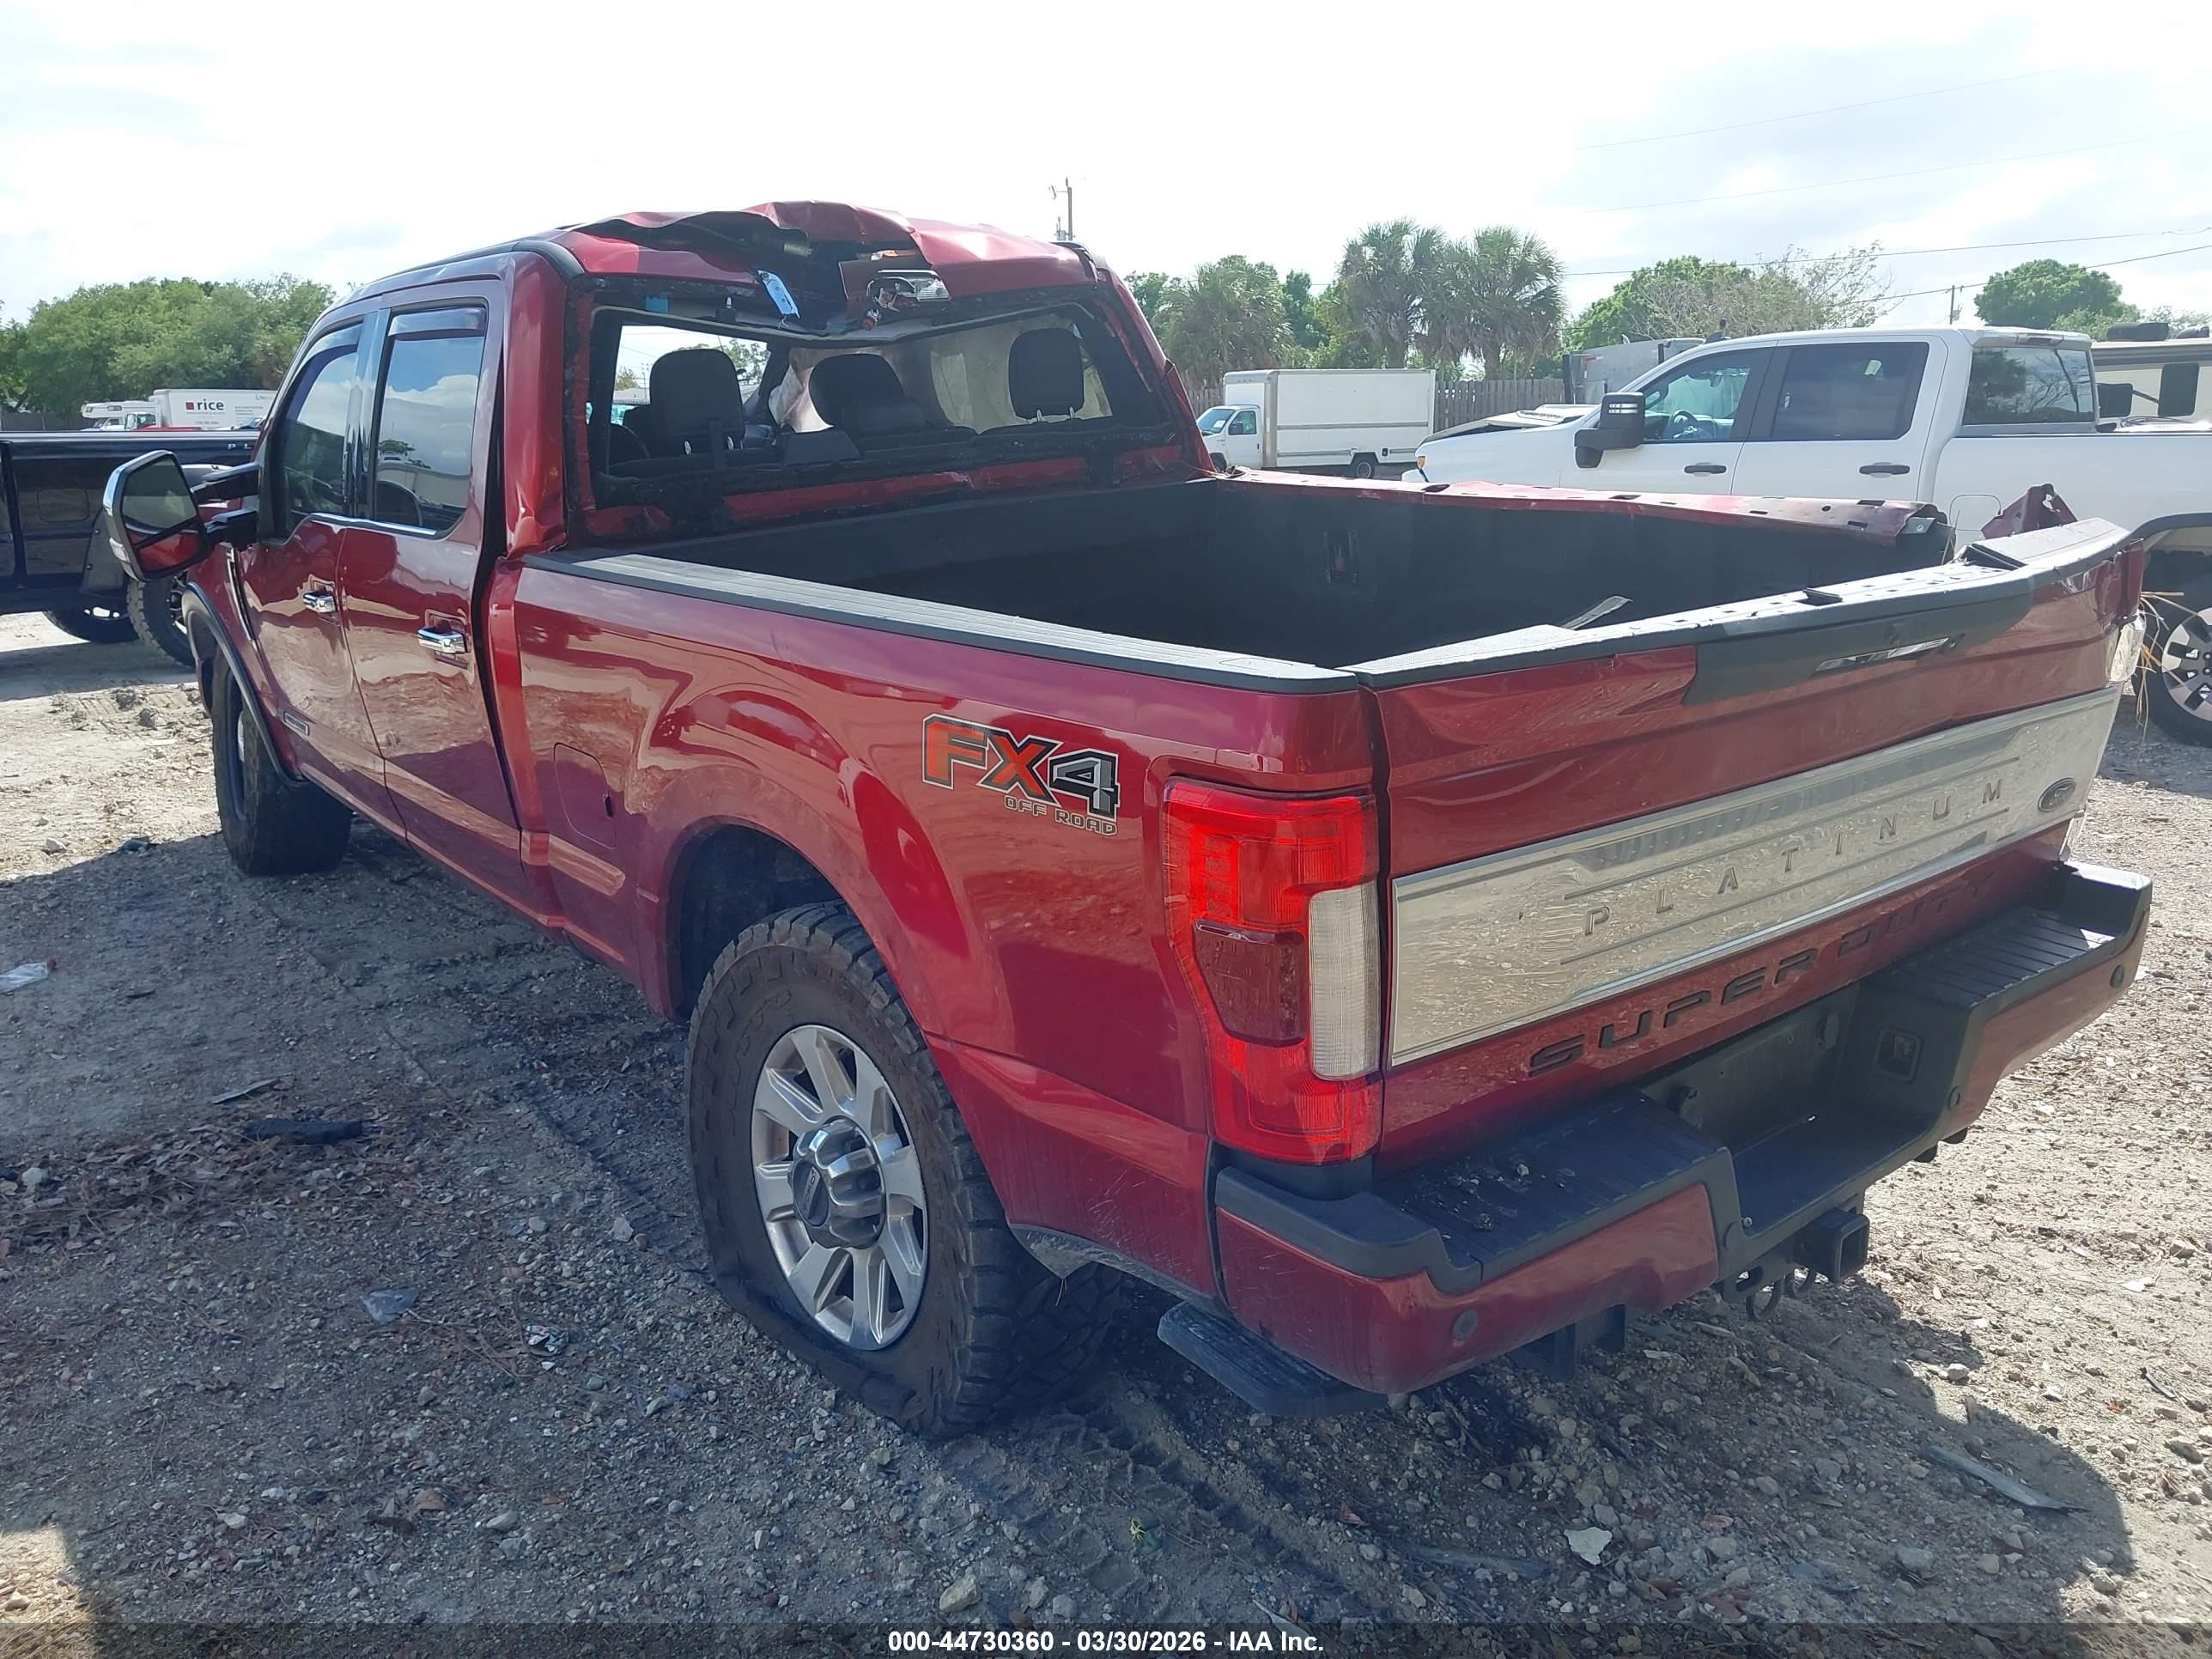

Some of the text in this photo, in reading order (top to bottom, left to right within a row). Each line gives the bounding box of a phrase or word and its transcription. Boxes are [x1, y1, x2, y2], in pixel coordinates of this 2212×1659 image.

[197, 398, 224, 410] rice
[923, 714, 1120, 822] FX4
[1004, 795, 1117, 836] OFF ROAD
[1584, 779, 2004, 937] PLATINUM
[1528, 947, 1820, 1077] SUPER
